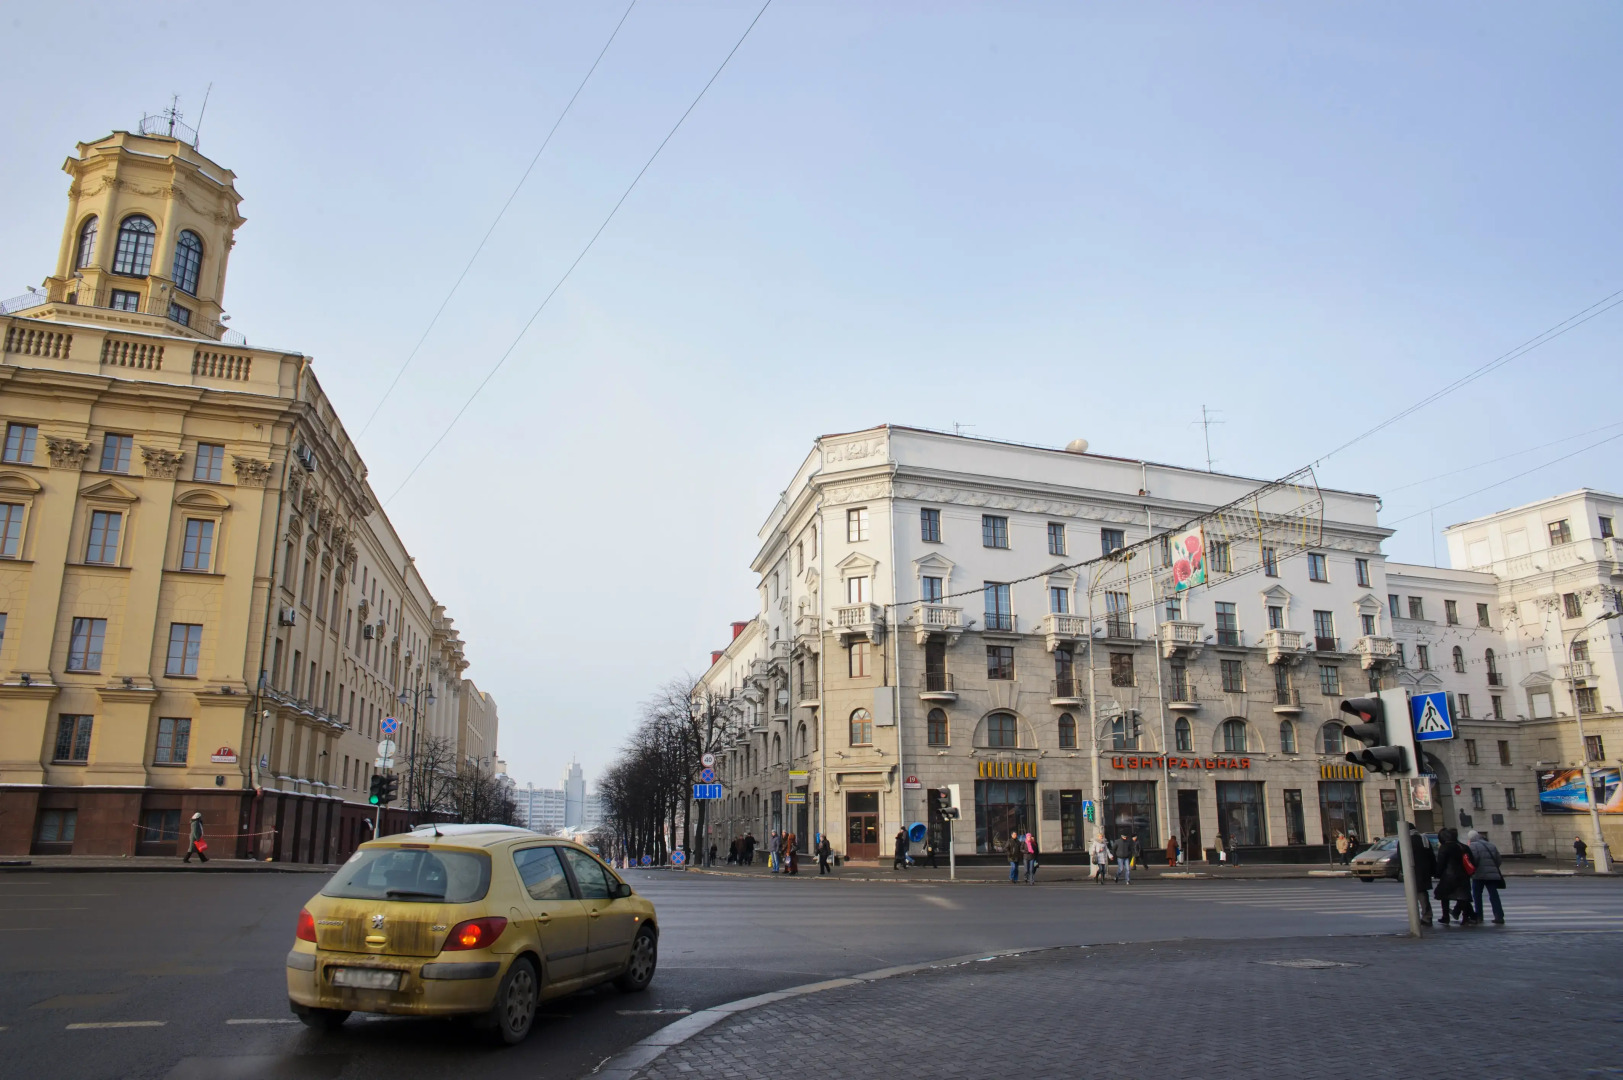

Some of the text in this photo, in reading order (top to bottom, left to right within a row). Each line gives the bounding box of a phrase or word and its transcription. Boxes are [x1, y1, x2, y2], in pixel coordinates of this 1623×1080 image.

[220, 748, 229, 756] 17
[1112, 757, 1251, 769] ЦЭНТРАЛЬНАЯ
[979, 761, 1037, 778] КНІГАРНЯ
